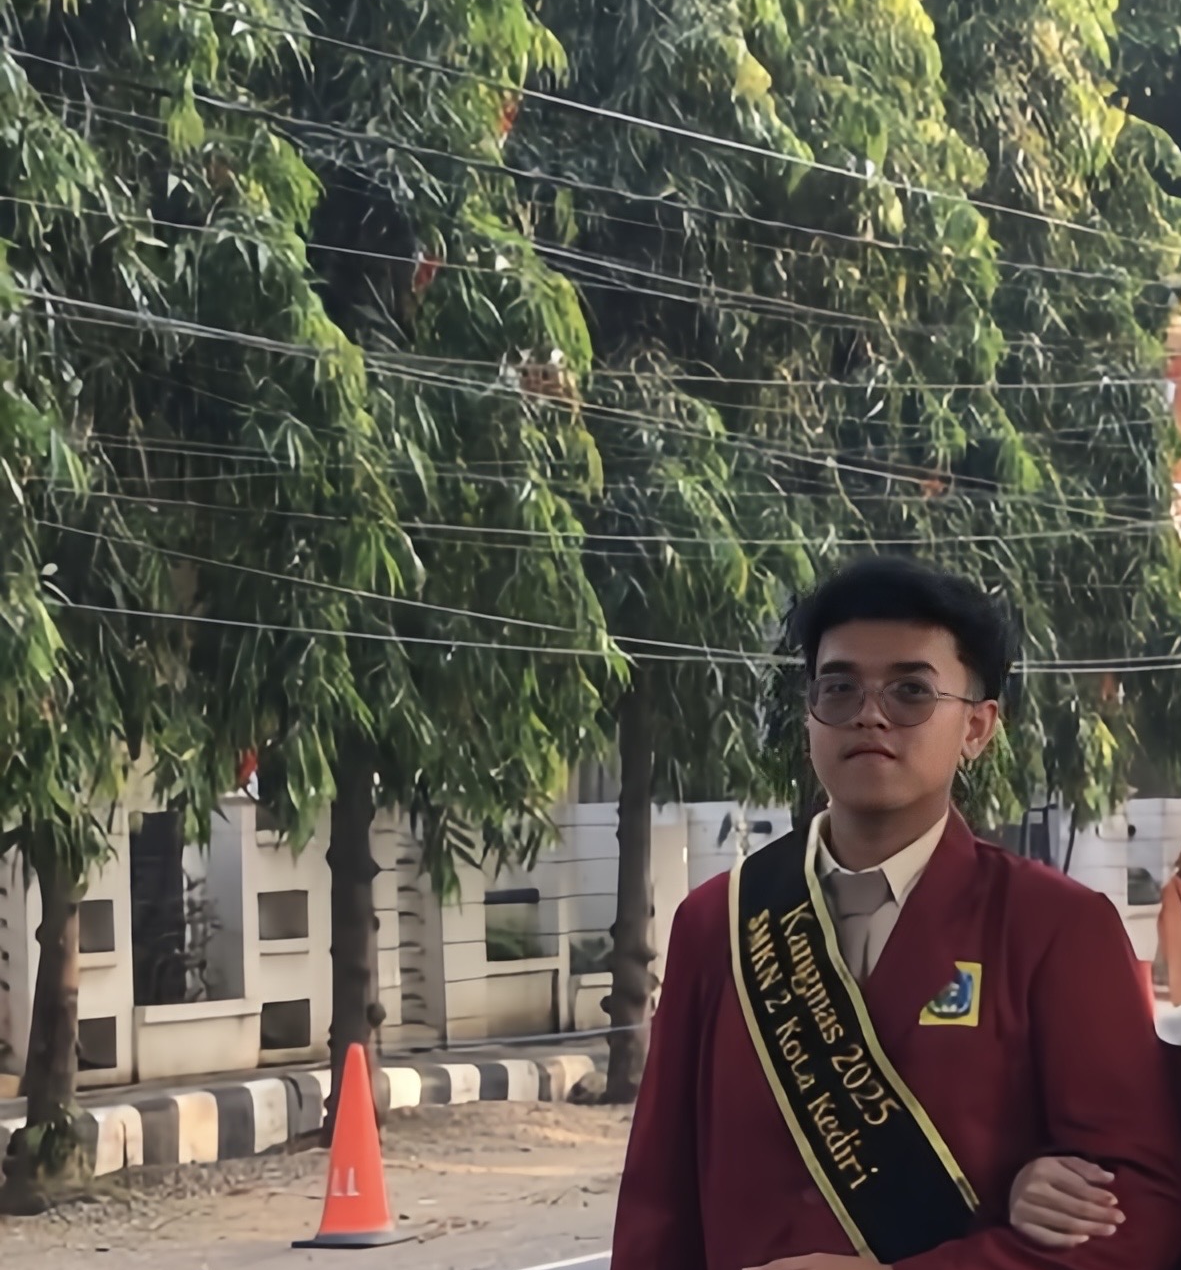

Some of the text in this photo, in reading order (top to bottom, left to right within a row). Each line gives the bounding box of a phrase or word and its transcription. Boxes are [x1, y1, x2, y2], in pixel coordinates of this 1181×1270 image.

[748, 909, 783, 991] SMKN
[765, 990, 792, 1014] 2
[780, 901, 901, 1125] Kangmas 2025
[807, 1092, 878, 1189] Kediri
